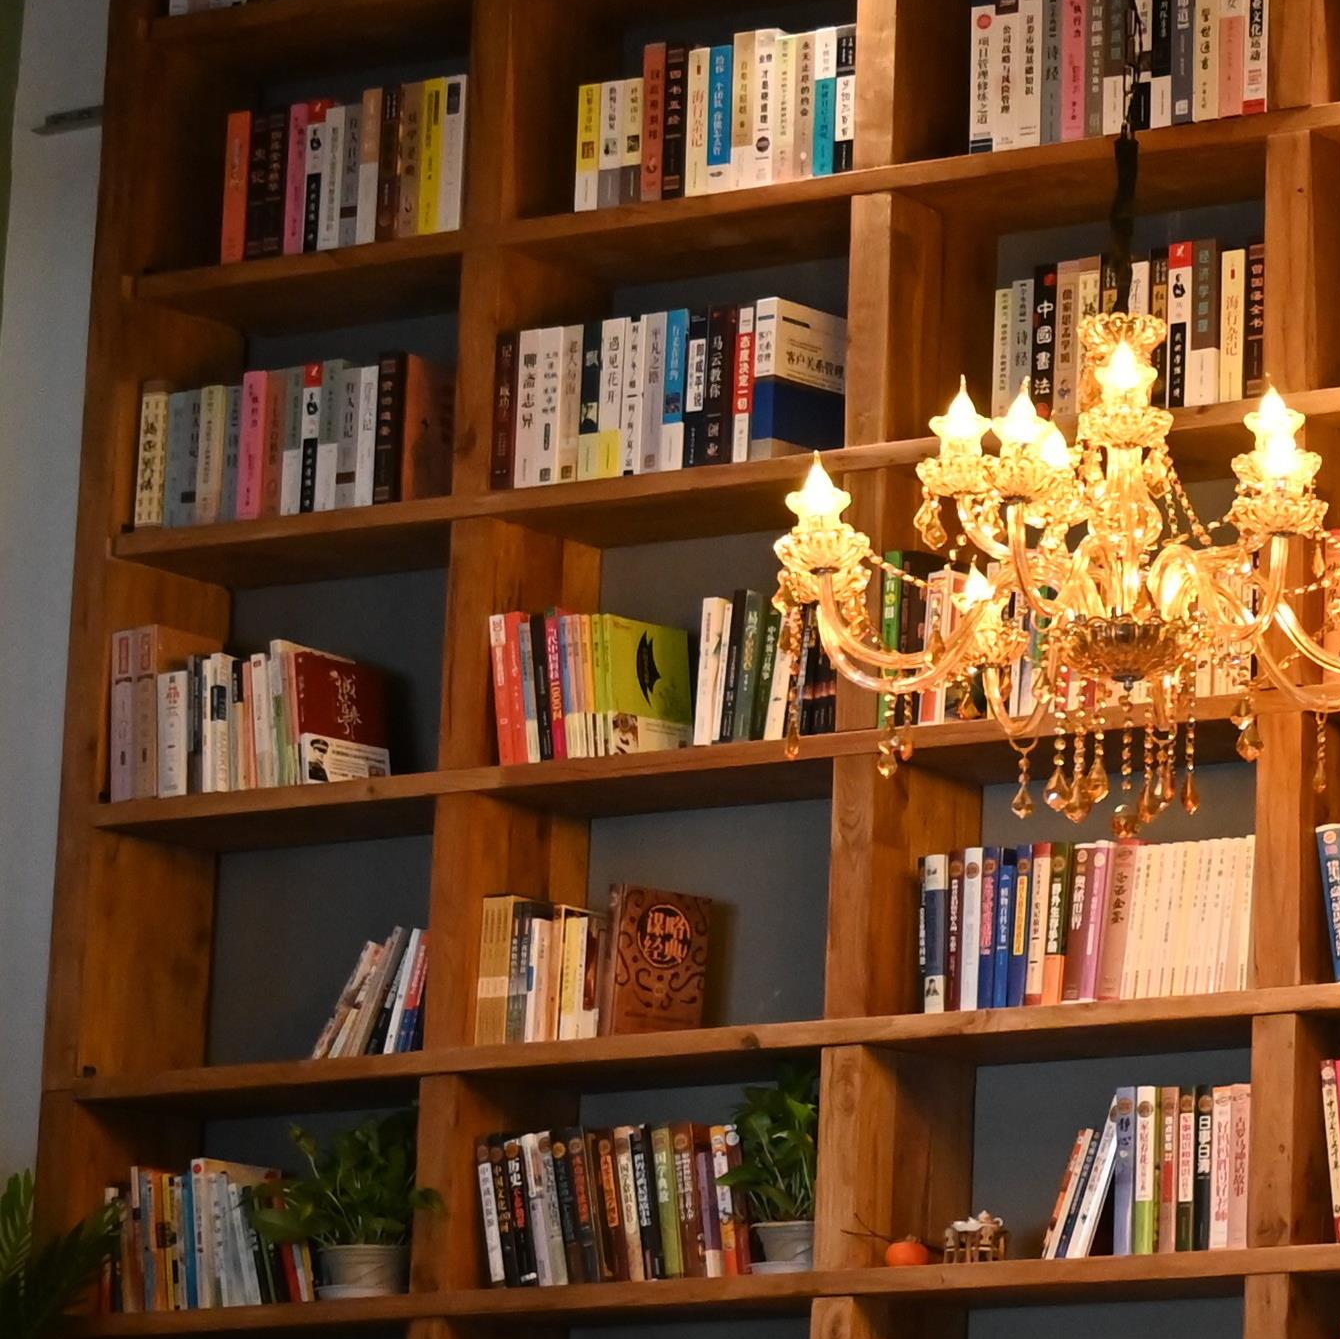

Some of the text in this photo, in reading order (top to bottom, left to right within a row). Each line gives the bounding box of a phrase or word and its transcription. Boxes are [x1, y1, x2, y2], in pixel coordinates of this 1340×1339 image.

[1000, 24, 1011, 114] 公司战略与风险管理
[1024, 14, 1035, 96] 证券市场基础知识
[667, 70, 681, 125] 四书五经
[709, 335, 723, 398] 马云教你
[786, 349, 845, 378] 客户关系管理
[1034, 300, 1054, 396] 中國書法
[707, 422, 719, 455] 创业
